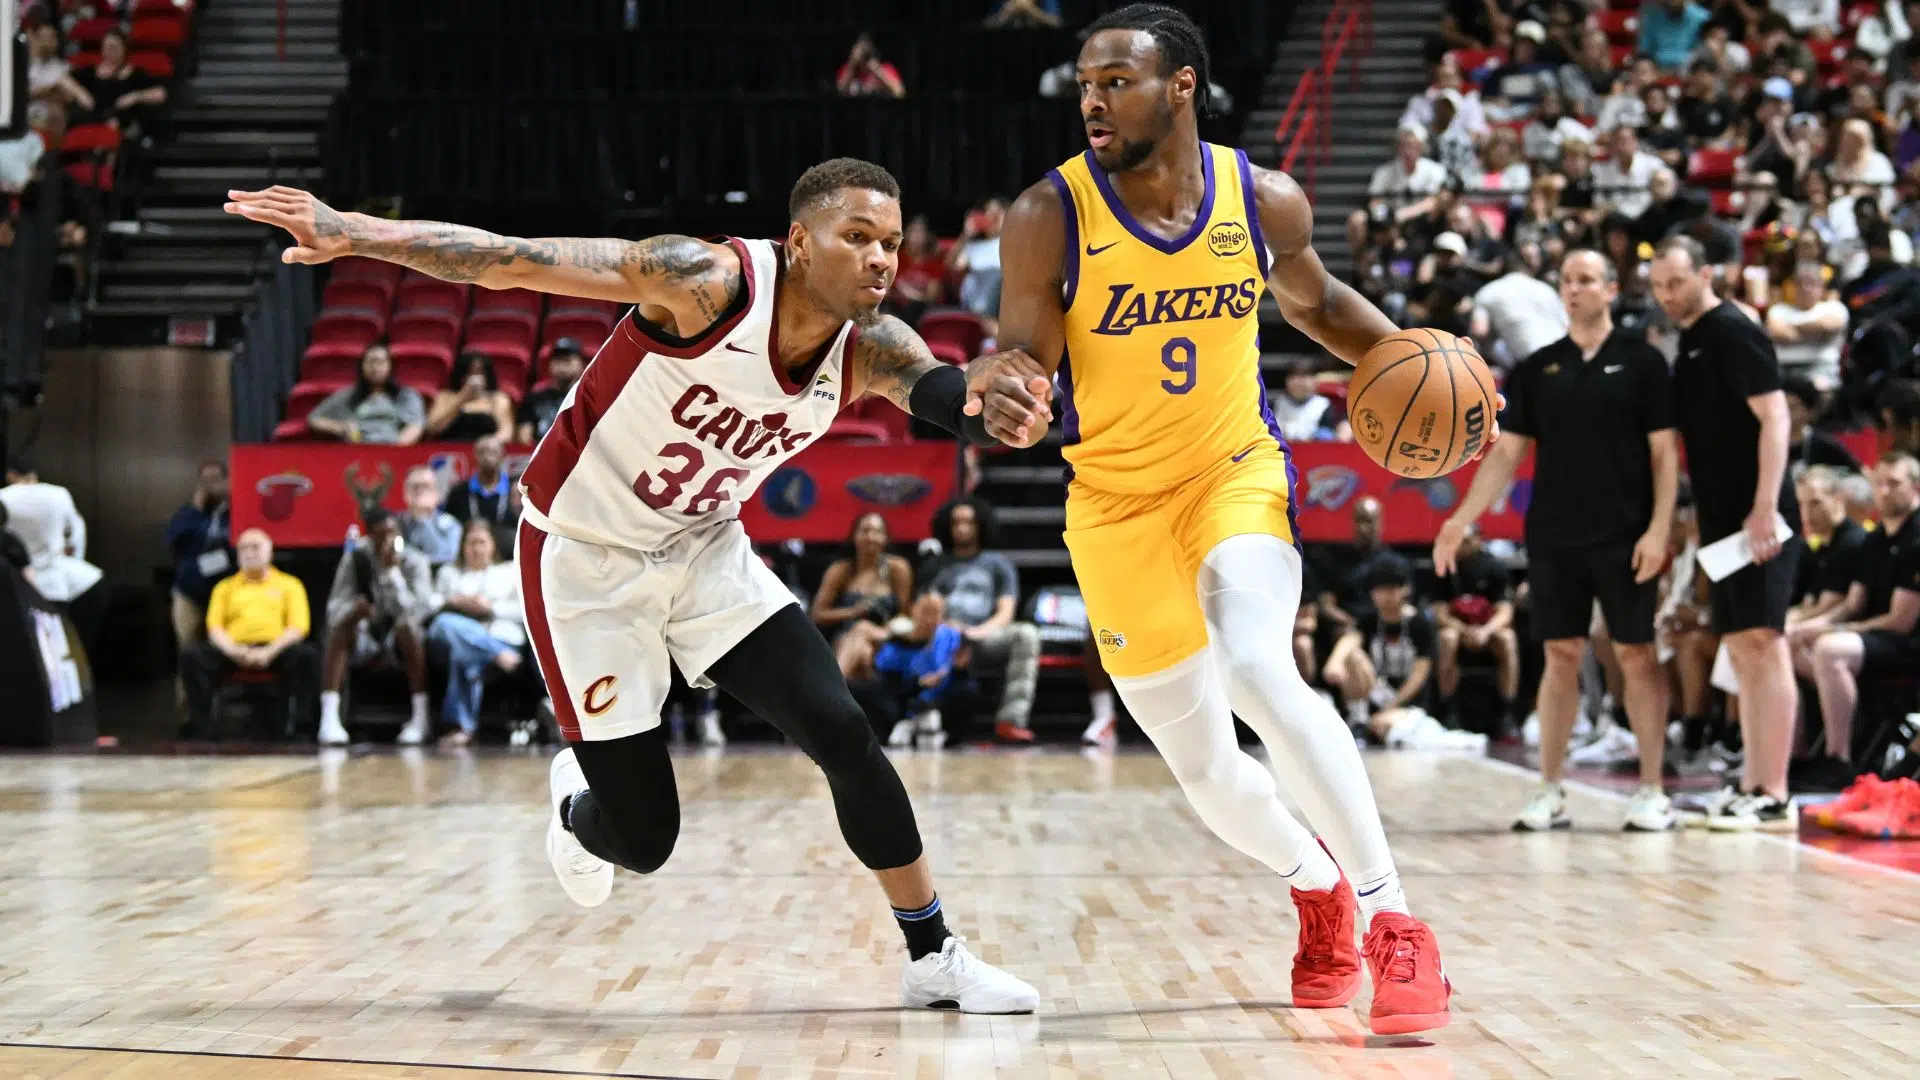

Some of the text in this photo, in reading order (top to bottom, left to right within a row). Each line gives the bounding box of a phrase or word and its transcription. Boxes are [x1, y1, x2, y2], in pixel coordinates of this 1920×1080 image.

[1211, 231, 1246, 245] bibigo
[1090, 277, 1257, 336] LAKERS
[1161, 336, 1197, 394] 9
[814, 389, 835, 401] IFFS
[633, 441, 750, 515] 36
